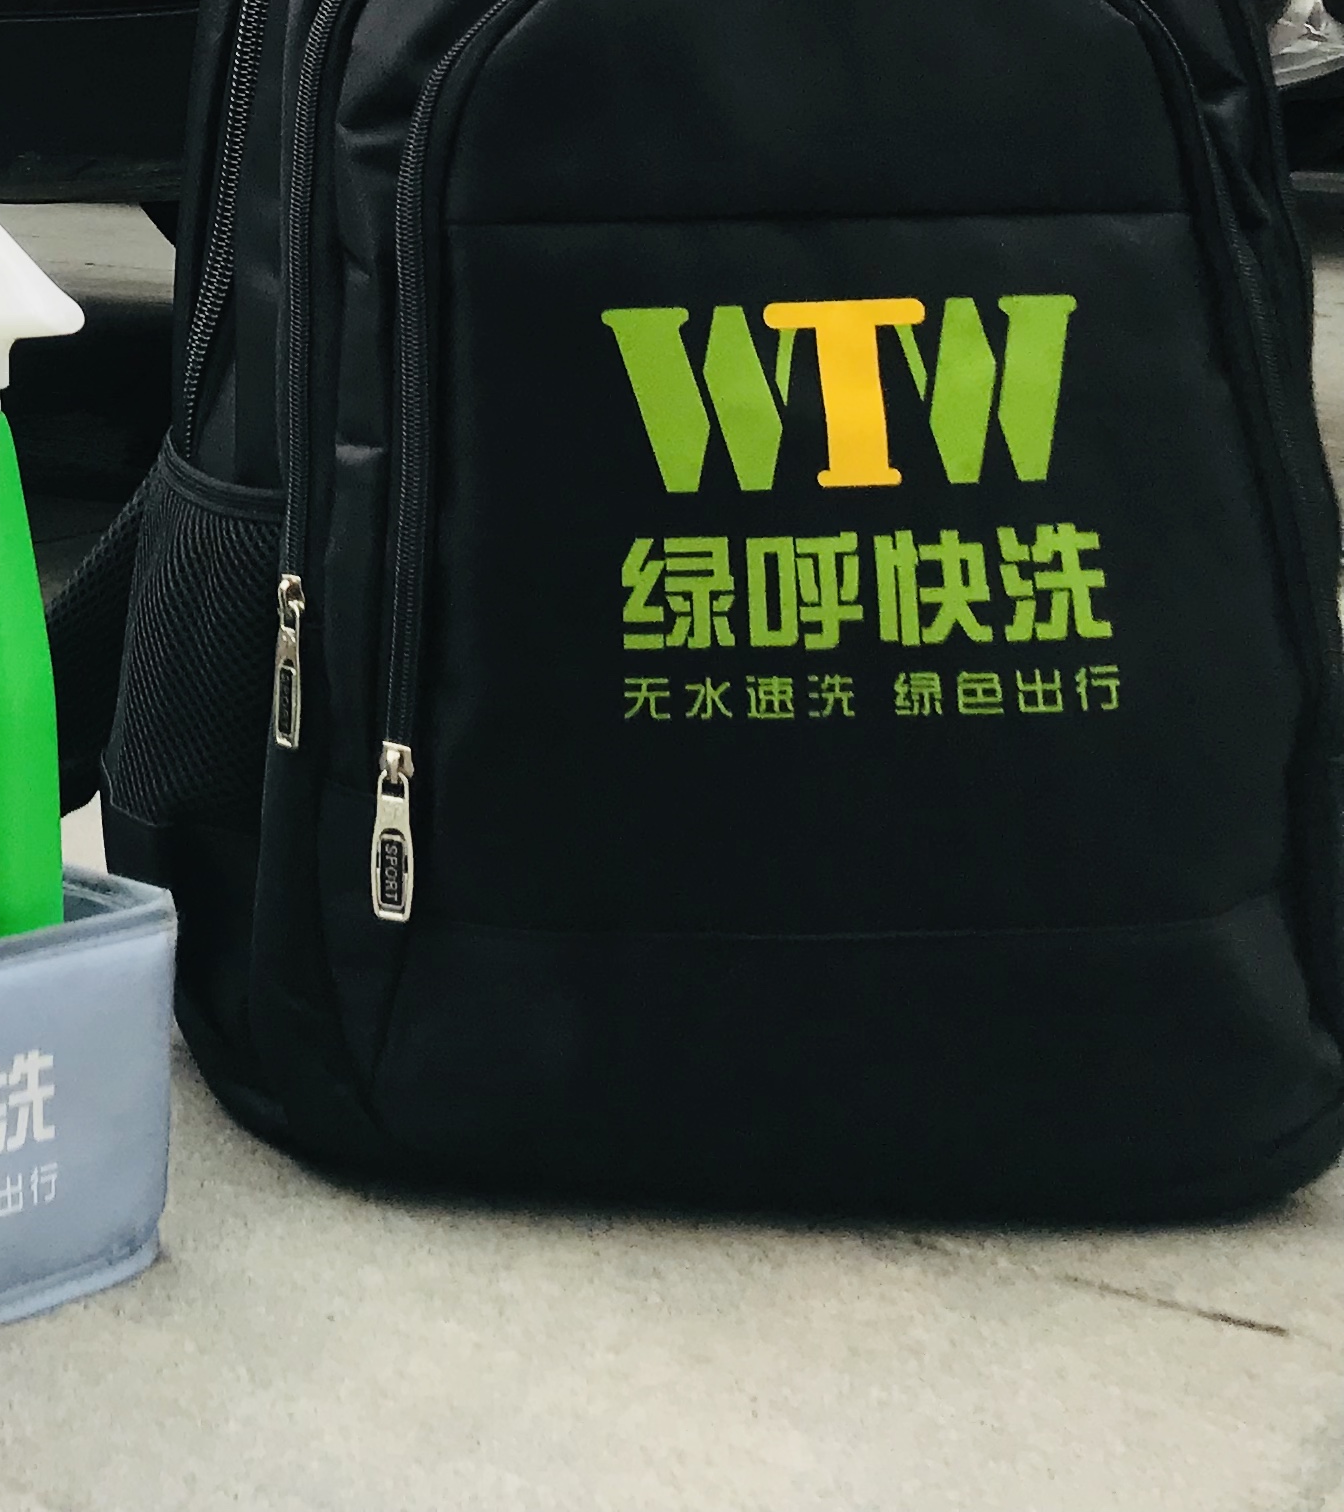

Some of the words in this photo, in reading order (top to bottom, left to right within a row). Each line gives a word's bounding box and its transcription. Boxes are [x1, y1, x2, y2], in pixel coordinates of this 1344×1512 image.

[601, 294, 1078, 492] WTW
[621, 522, 1113, 650] 绿呼快洗
[624, 675, 855, 721] 无水速洗
[893, 664, 1121, 716] 绿色出行
[384, 843, 400, 902] SPORT
